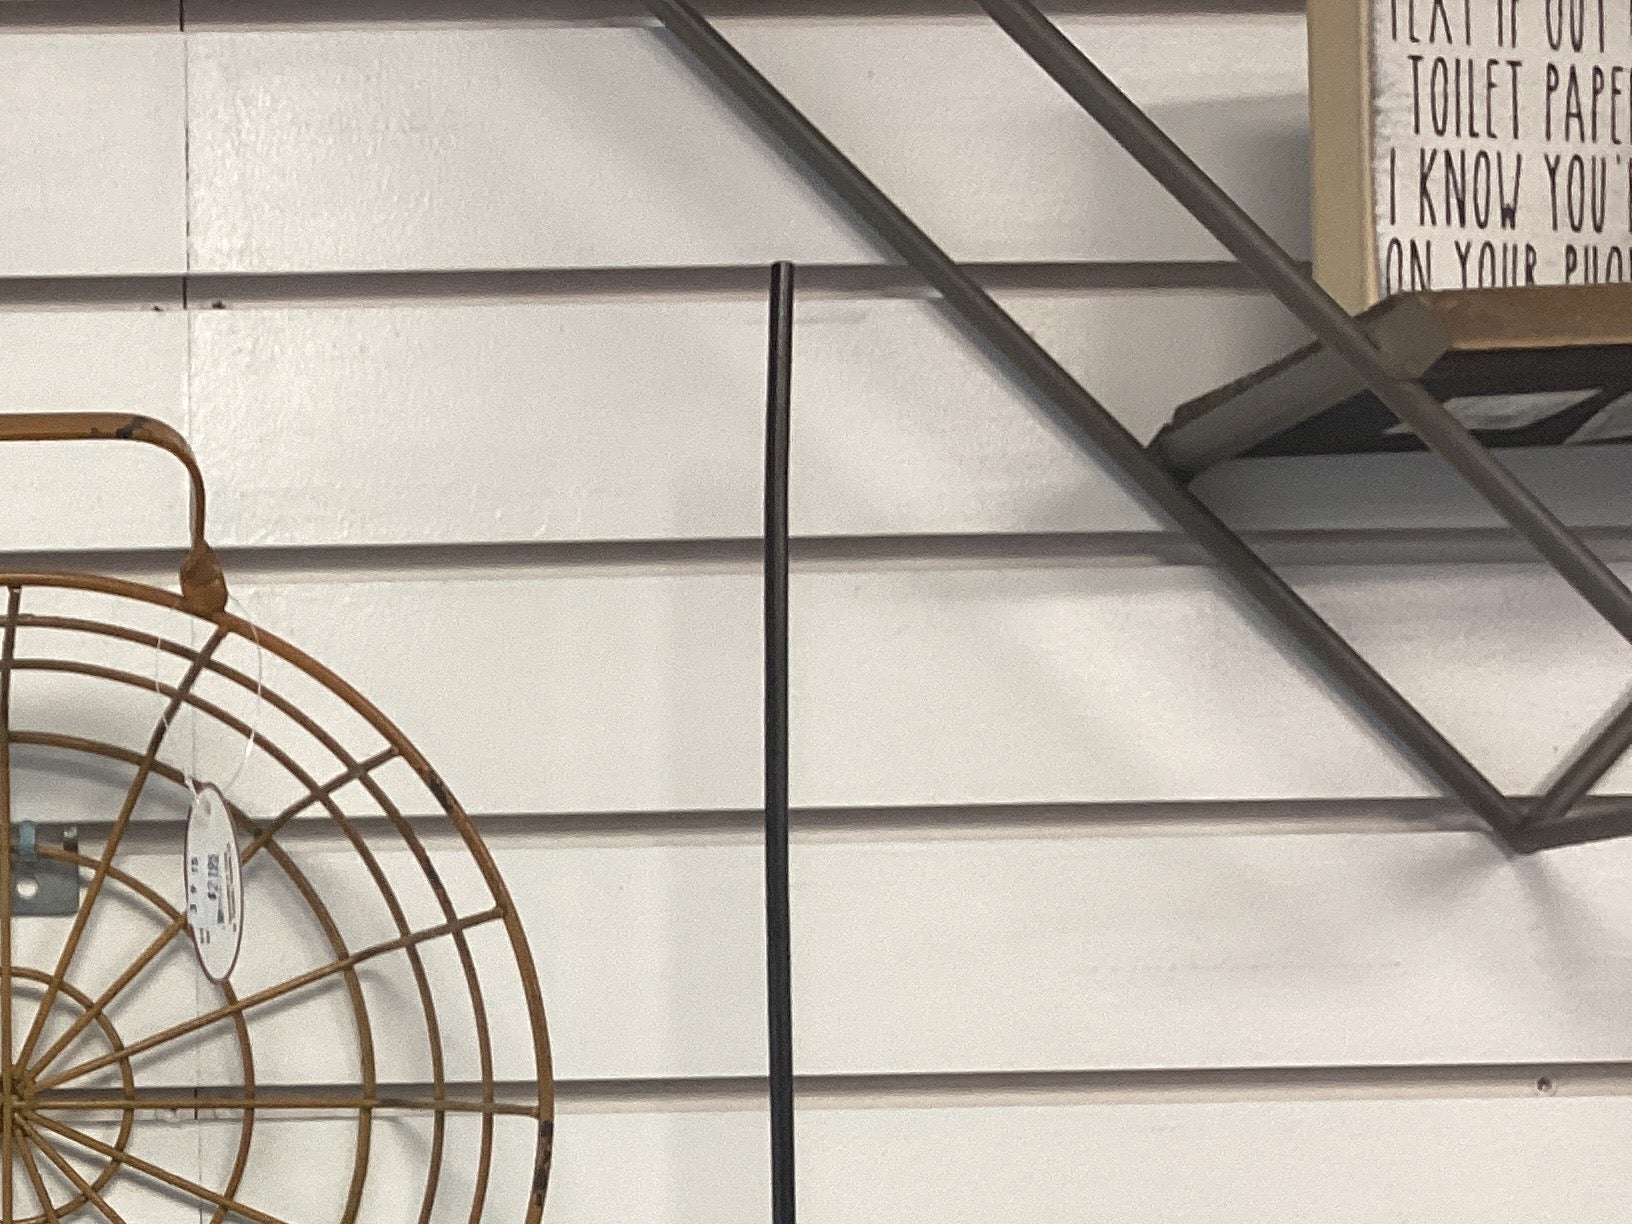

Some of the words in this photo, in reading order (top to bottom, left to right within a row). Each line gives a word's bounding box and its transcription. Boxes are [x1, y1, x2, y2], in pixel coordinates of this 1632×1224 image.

[1407, 54, 1523, 139] TOILET
[1544, 62, 1632, 144] PAPE
[1389, 147, 1397, 226] I
[1419, 147, 1523, 230] KNOW
[1386, 237, 1432, 296] ON
[1454, 239, 1538, 290] YOUR
[1565, 243, 1632, 286] PHO
